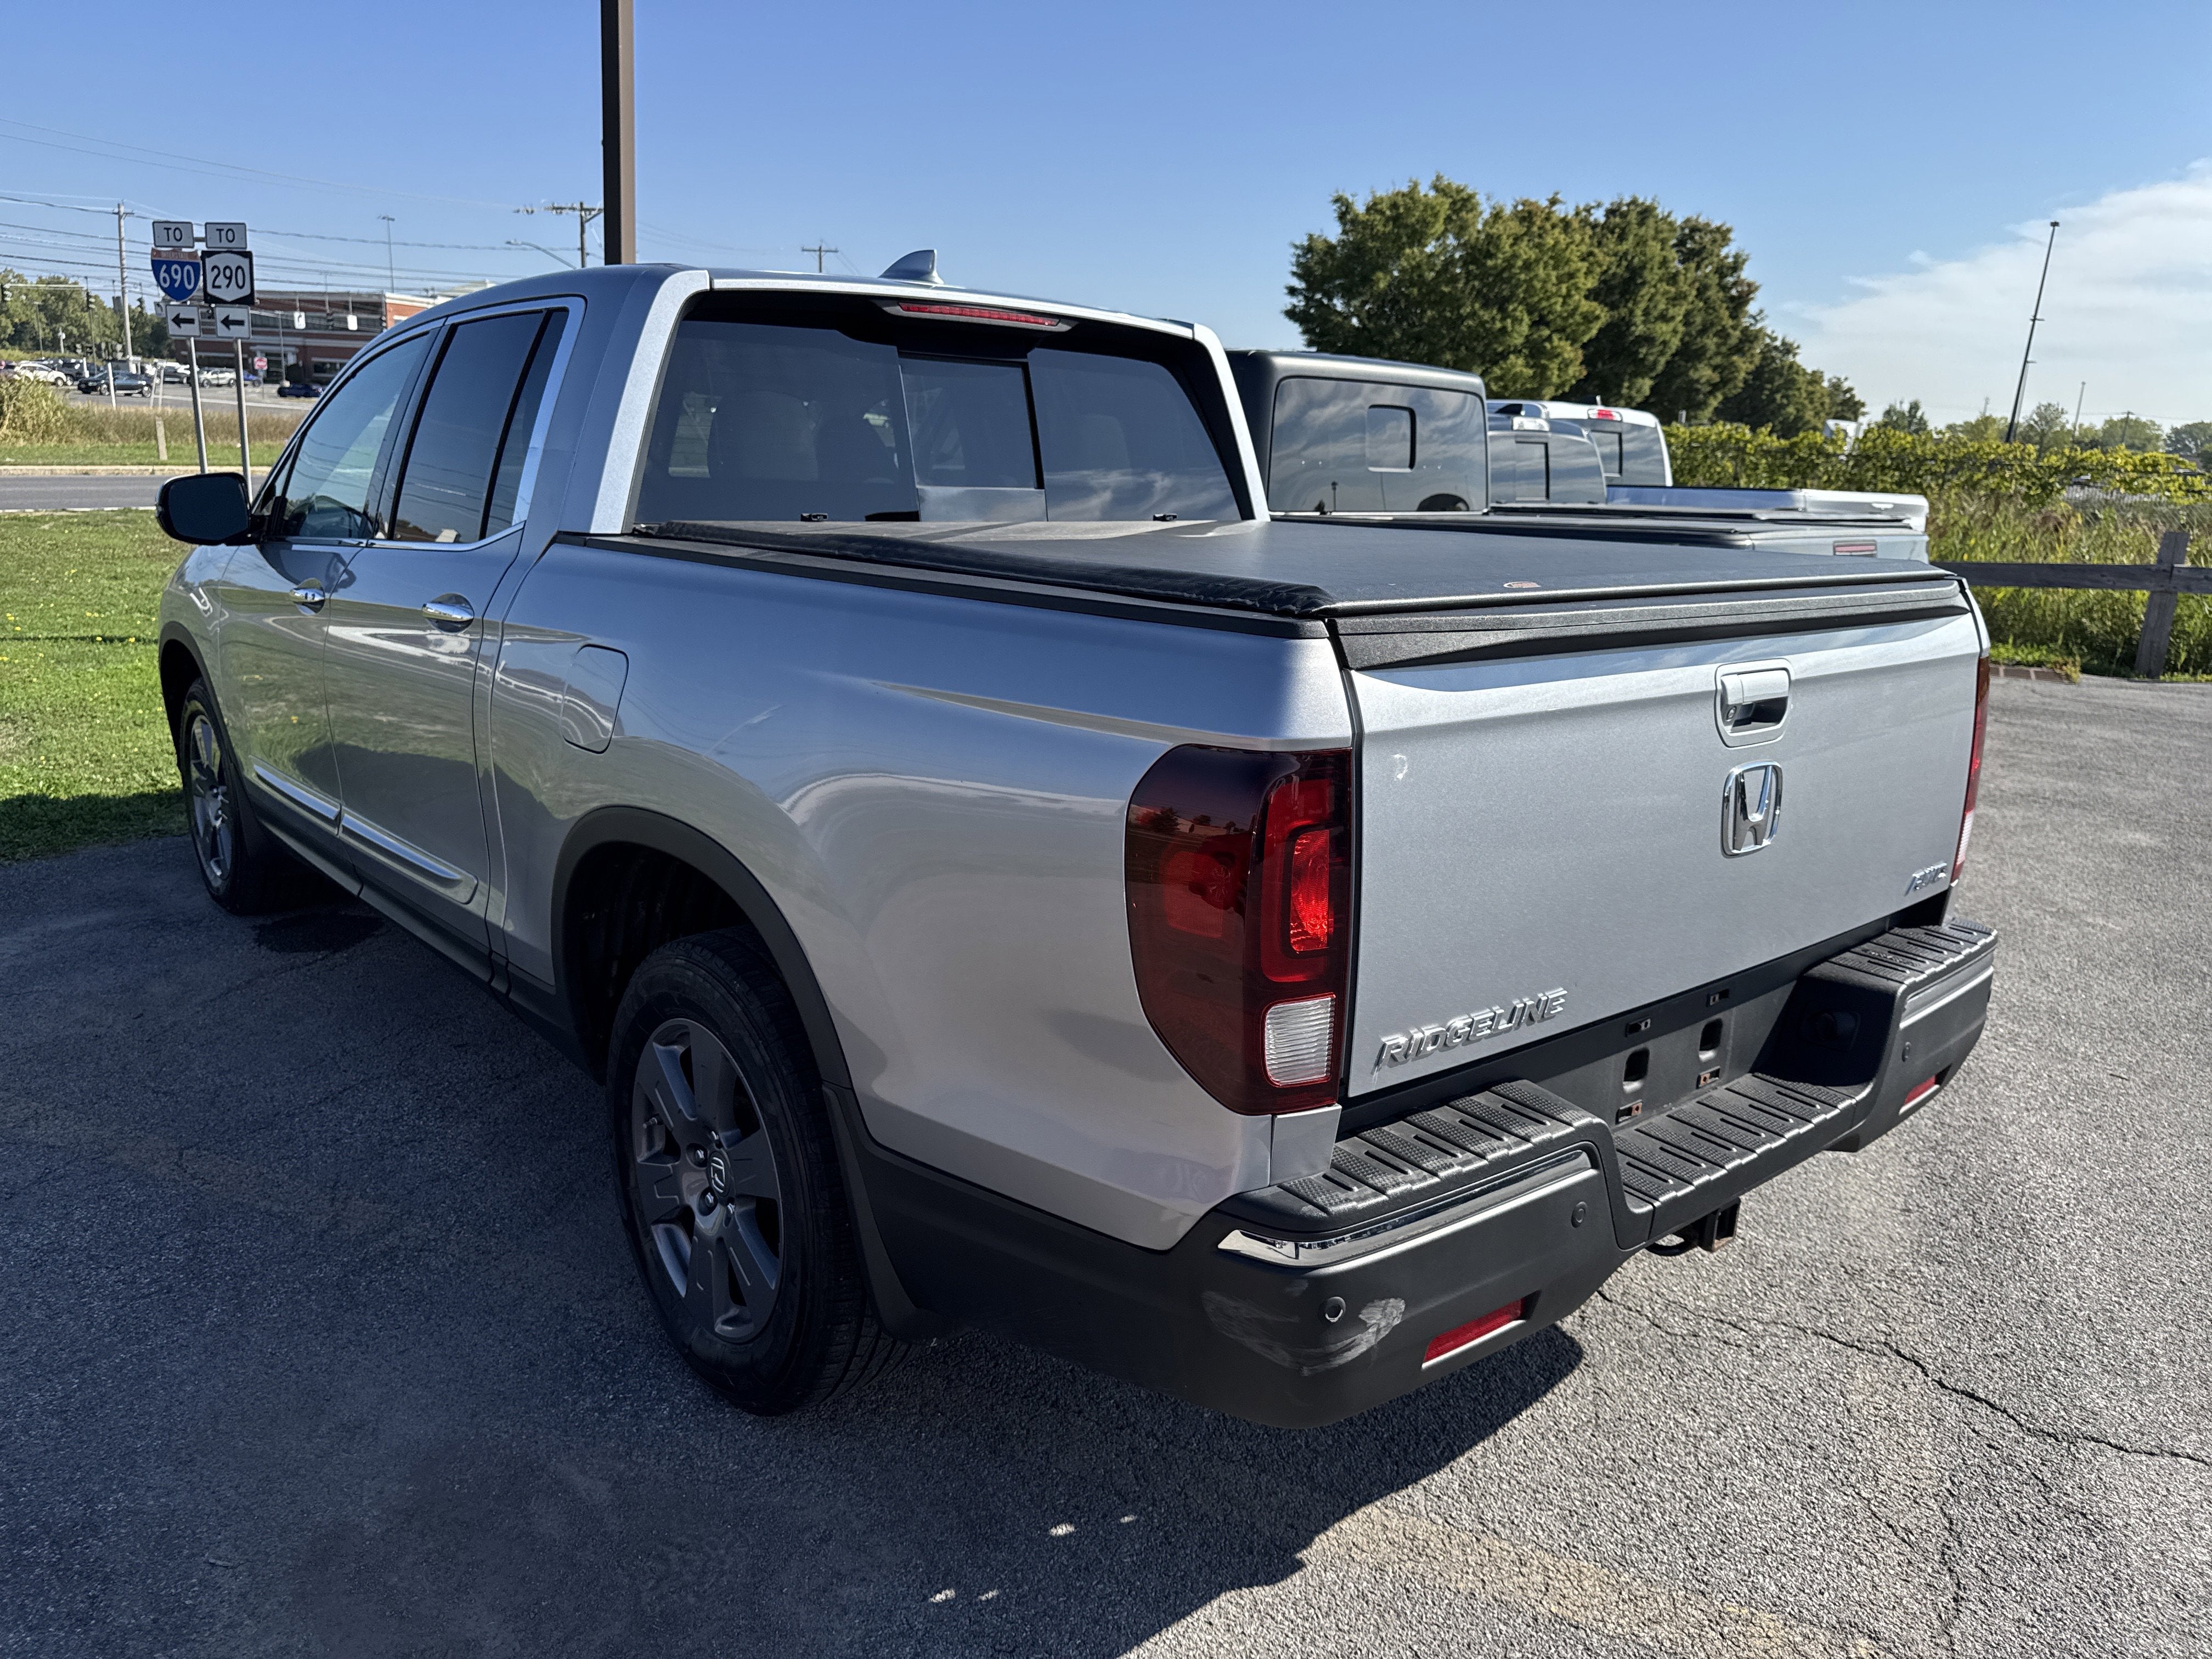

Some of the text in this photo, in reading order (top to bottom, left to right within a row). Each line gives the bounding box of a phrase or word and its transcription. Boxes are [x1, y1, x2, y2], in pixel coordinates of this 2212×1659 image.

[163, 227, 183, 242] TO
[216, 228, 235, 243] TO
[159, 263, 195, 290] 690
[211, 264, 246, 289] 290
[1373, 988, 1568, 1070] RIDGELINE
